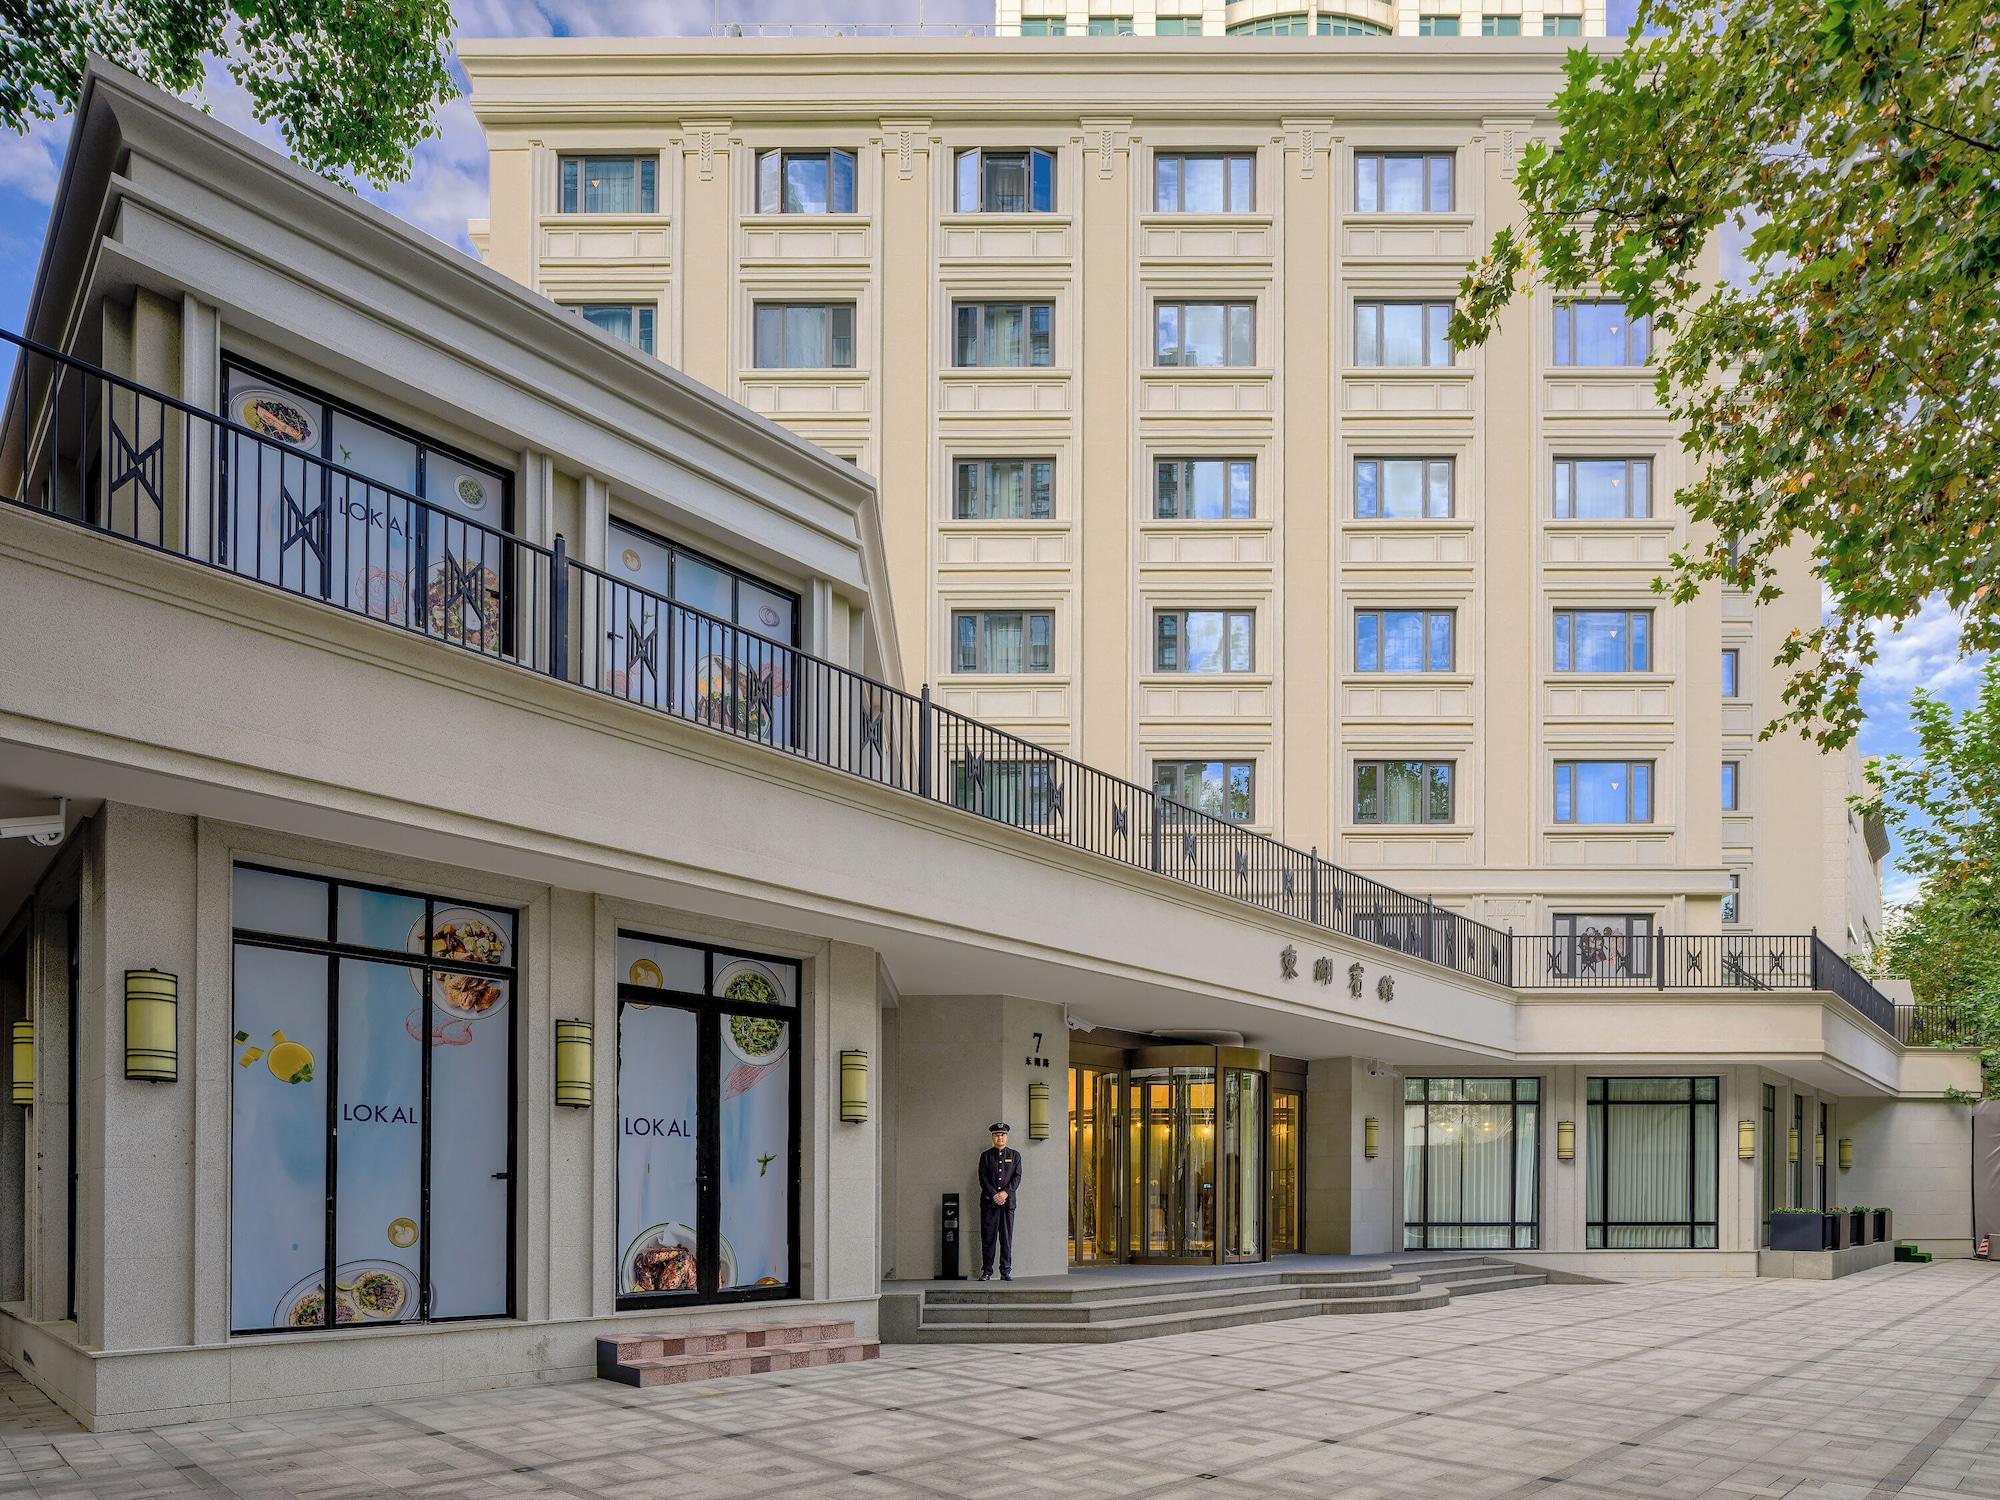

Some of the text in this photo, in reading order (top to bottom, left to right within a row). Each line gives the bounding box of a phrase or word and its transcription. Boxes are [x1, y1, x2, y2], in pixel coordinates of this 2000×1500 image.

[1032, 1032, 1043, 1053] 7
[344, 1103, 418, 1124] LOKAL
[625, 1117, 691, 1137] LOKAL
